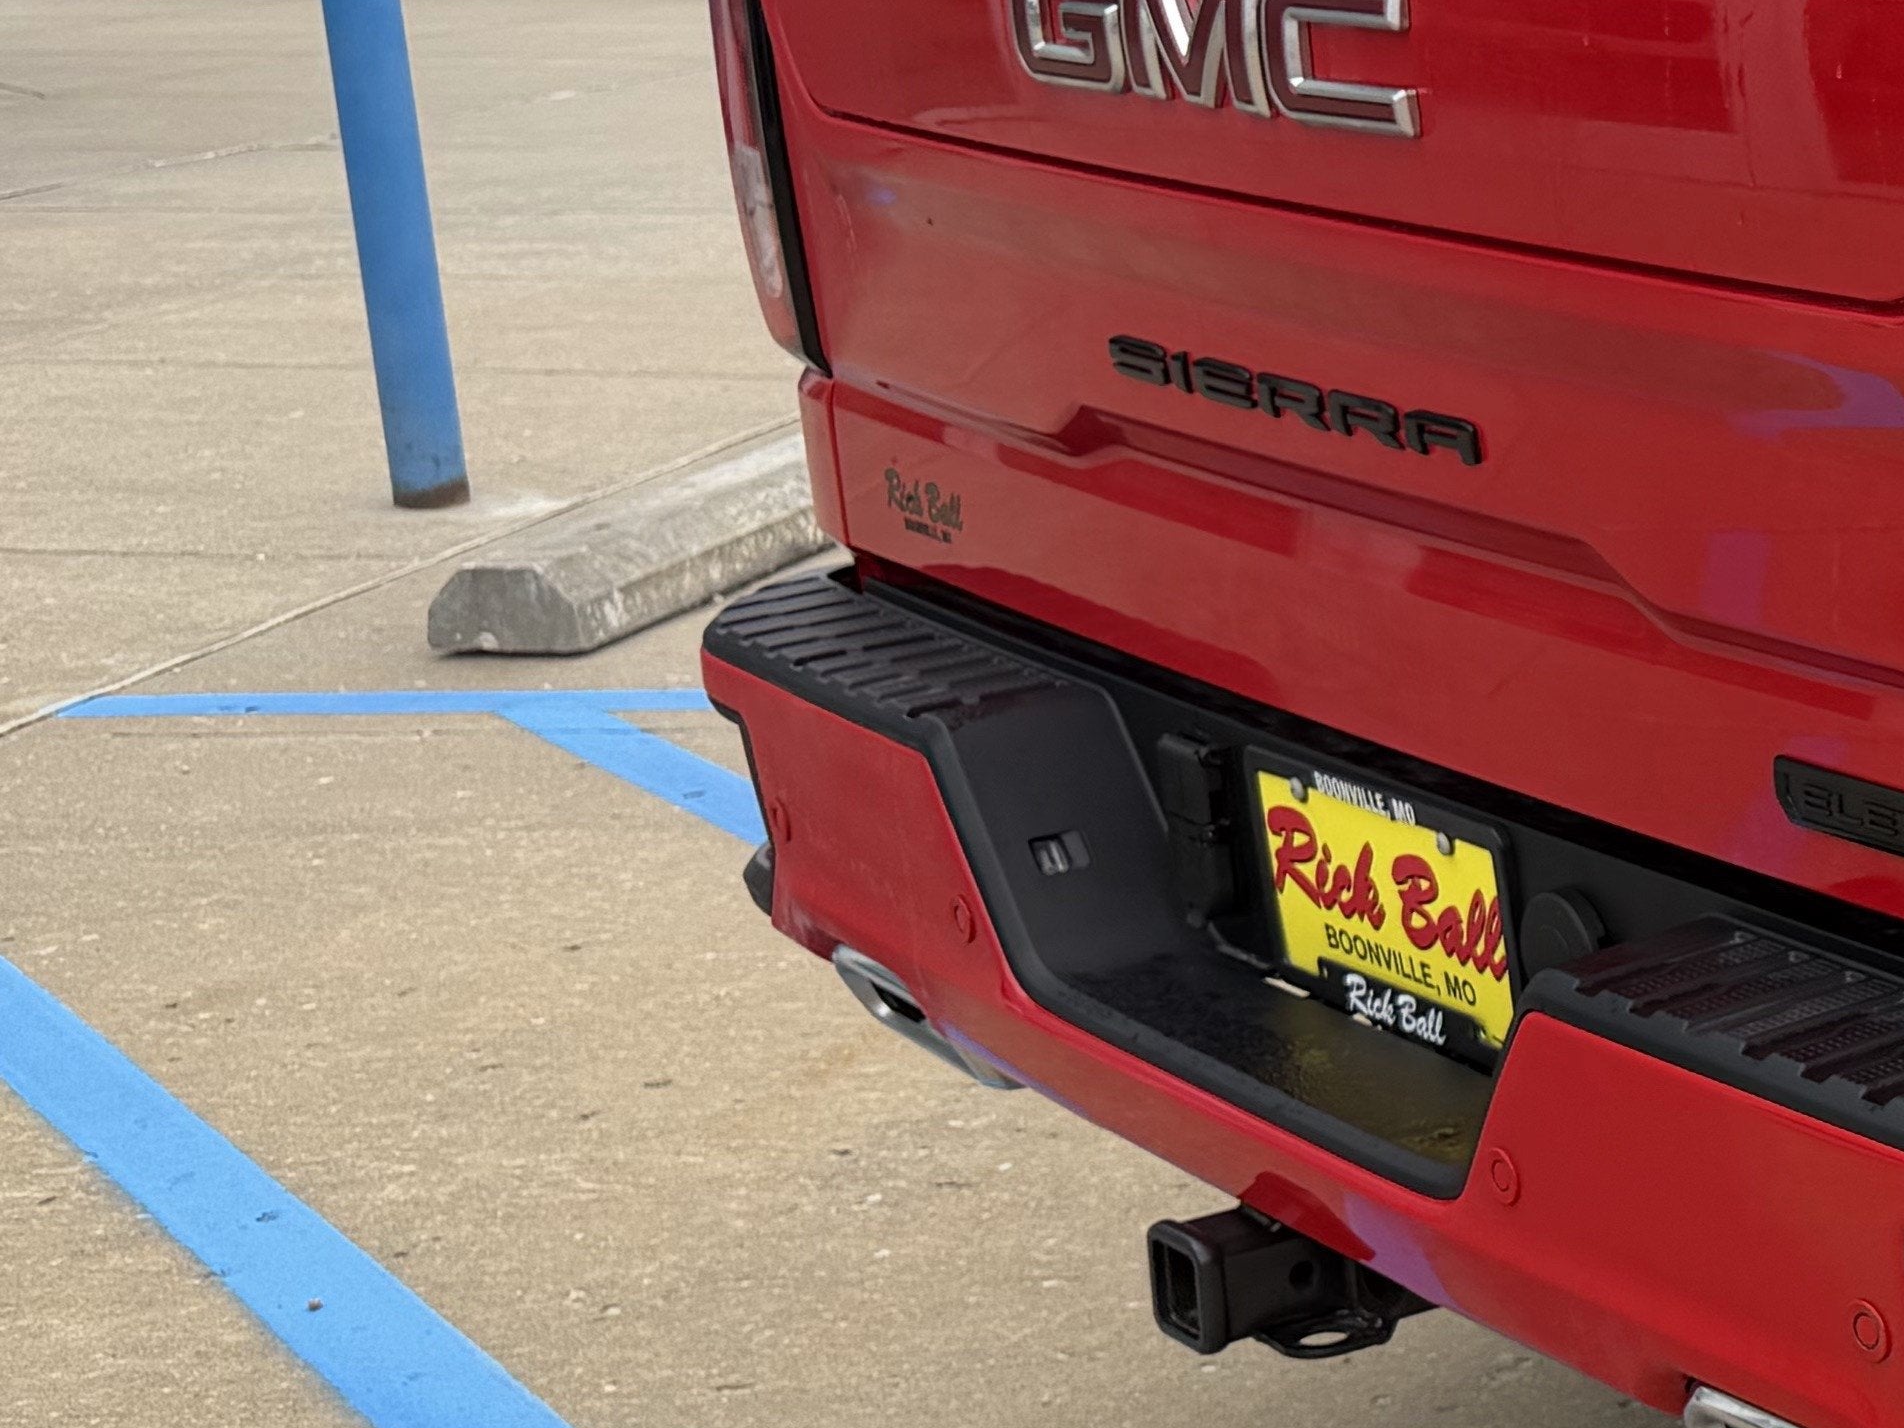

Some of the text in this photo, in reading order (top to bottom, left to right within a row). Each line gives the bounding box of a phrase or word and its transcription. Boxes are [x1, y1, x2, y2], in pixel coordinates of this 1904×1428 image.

[1108, 334, 1486, 466] SIERRA
[1313, 770, 1417, 826] BOONVILLE, MO
[1267, 804, 1508, 982] Rick Ball
[1324, 923, 1477, 1006] BOONVILLE, MO
[1343, 972, 1447, 1046] Rick Ball
